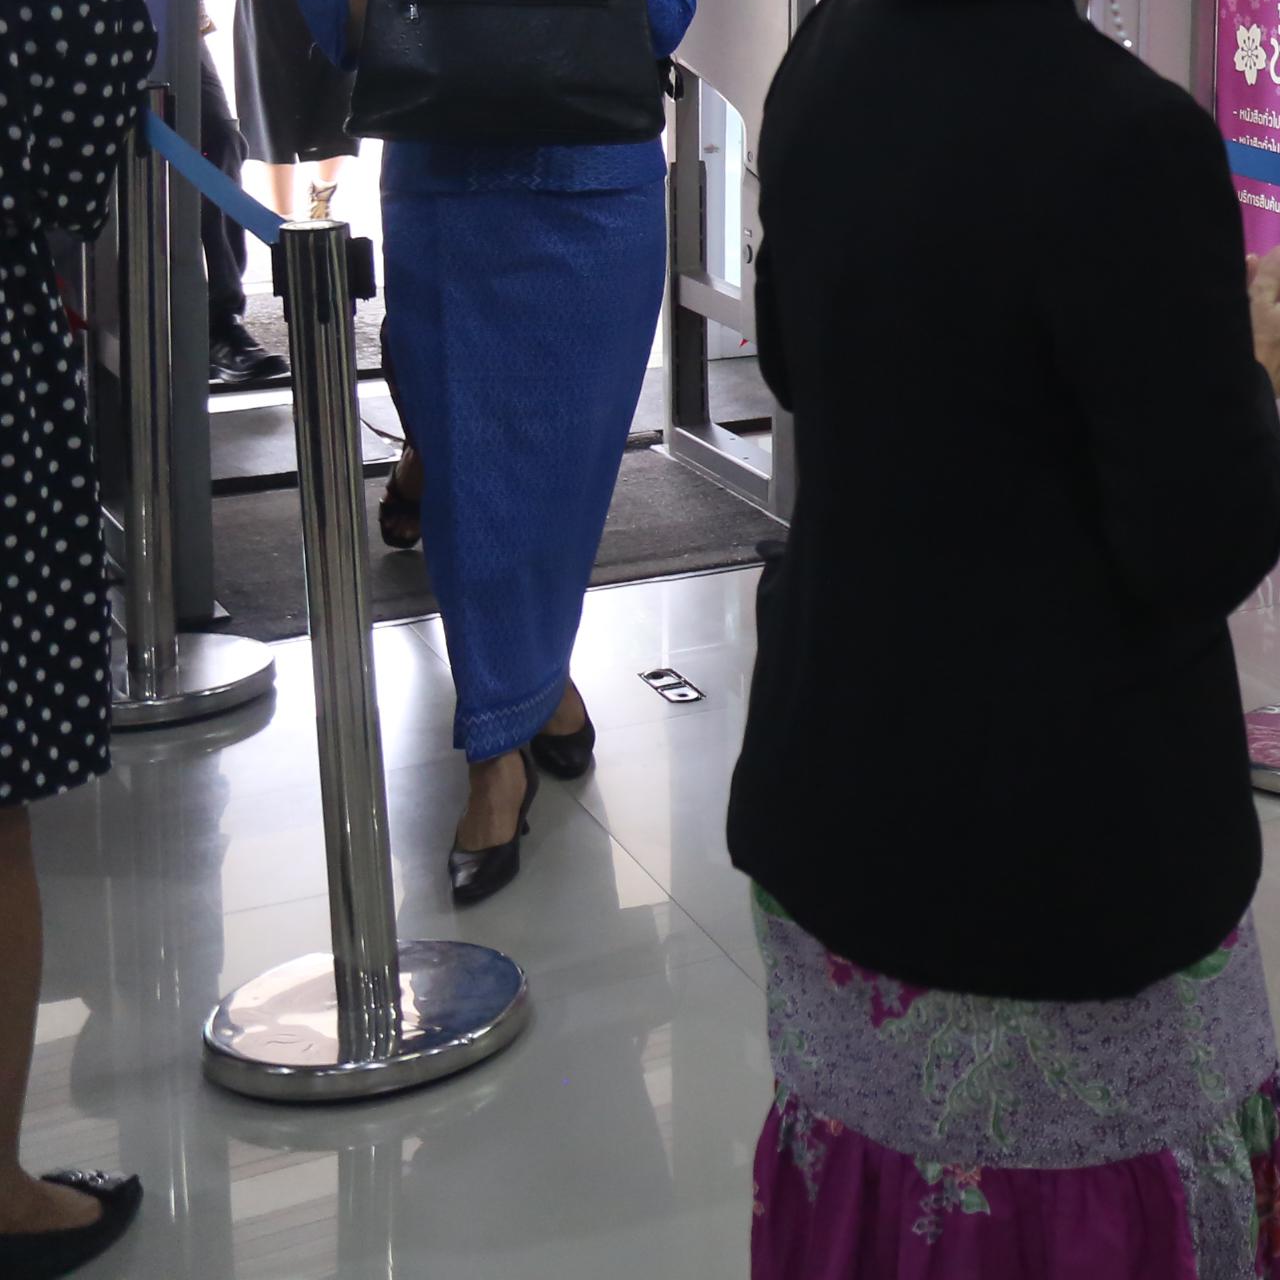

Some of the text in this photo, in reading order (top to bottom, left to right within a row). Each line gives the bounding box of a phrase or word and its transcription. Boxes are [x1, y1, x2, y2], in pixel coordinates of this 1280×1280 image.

[1239, 107, 1280, 129] หนังสือทั่วไป
